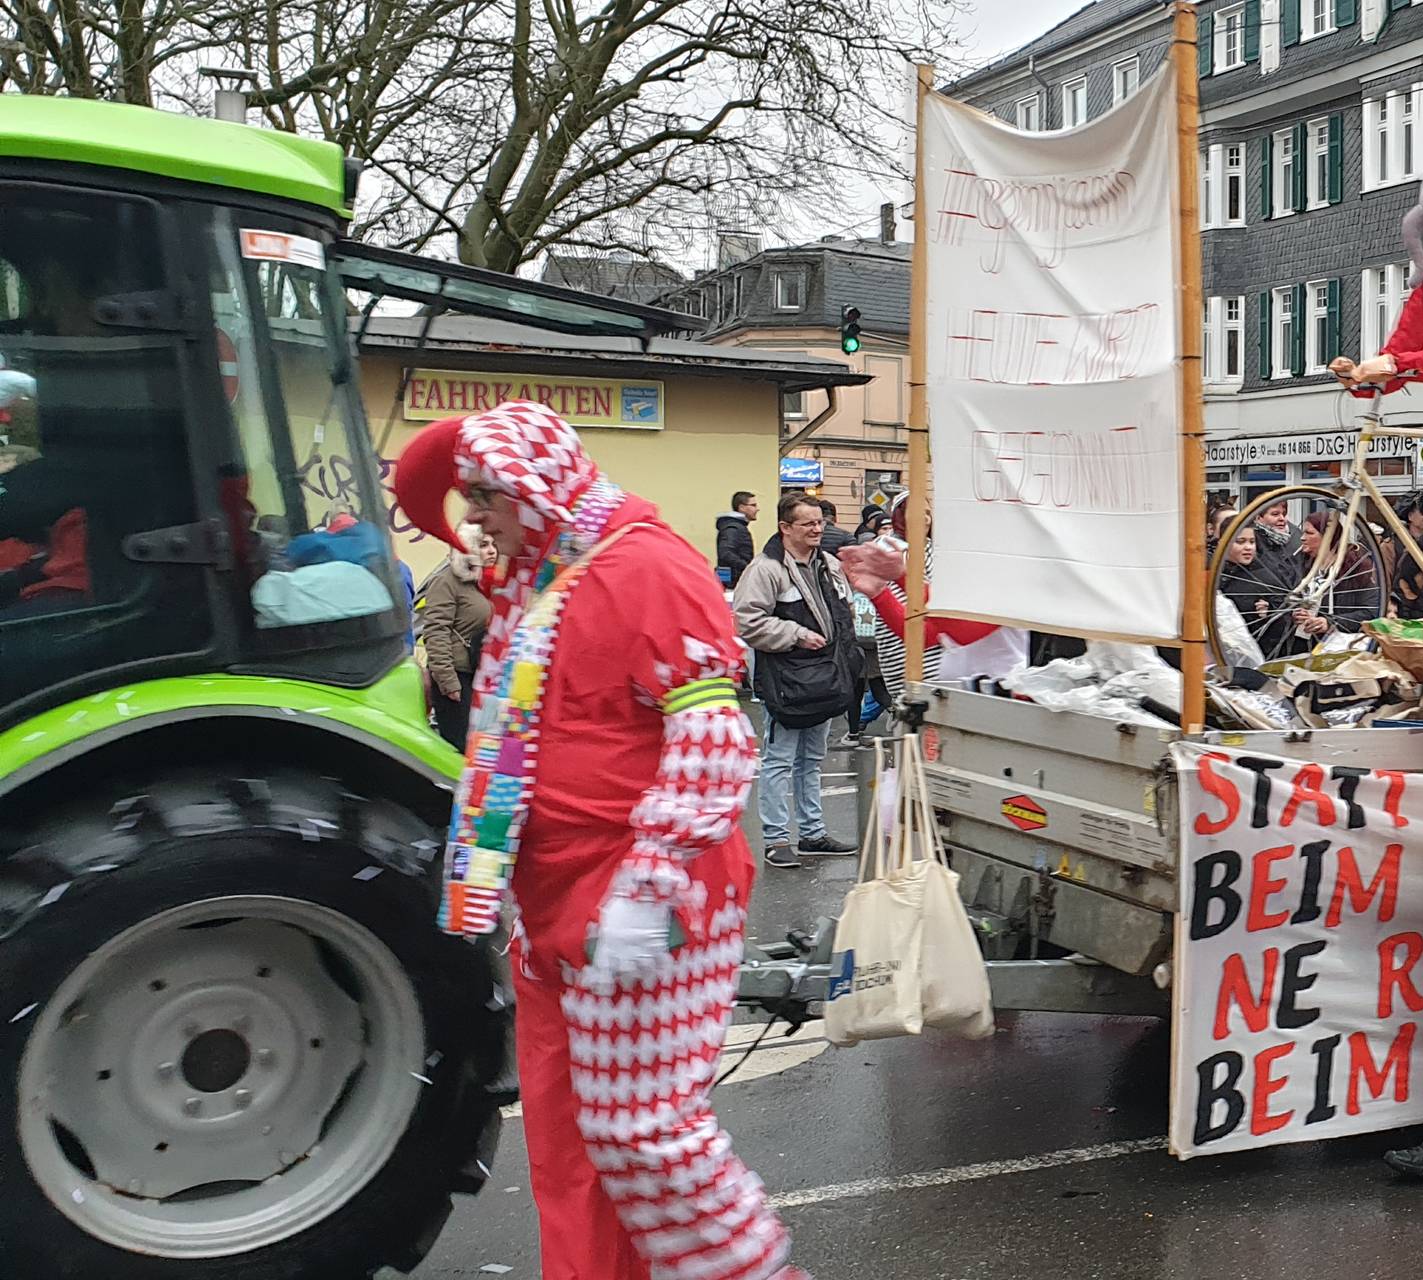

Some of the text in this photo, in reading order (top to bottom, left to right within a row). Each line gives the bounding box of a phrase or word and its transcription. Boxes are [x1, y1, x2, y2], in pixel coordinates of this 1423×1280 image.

[408, 378, 614, 417] FAHRKARTEN
[1316, 436, 1344, 456] D&G
[1194, 752, 1409, 835] STATT
[1190, 840, 1402, 940] BEIM
[1213, 940, 1327, 1041] NE
[1194, 1022, 1417, 1146] BEIM
